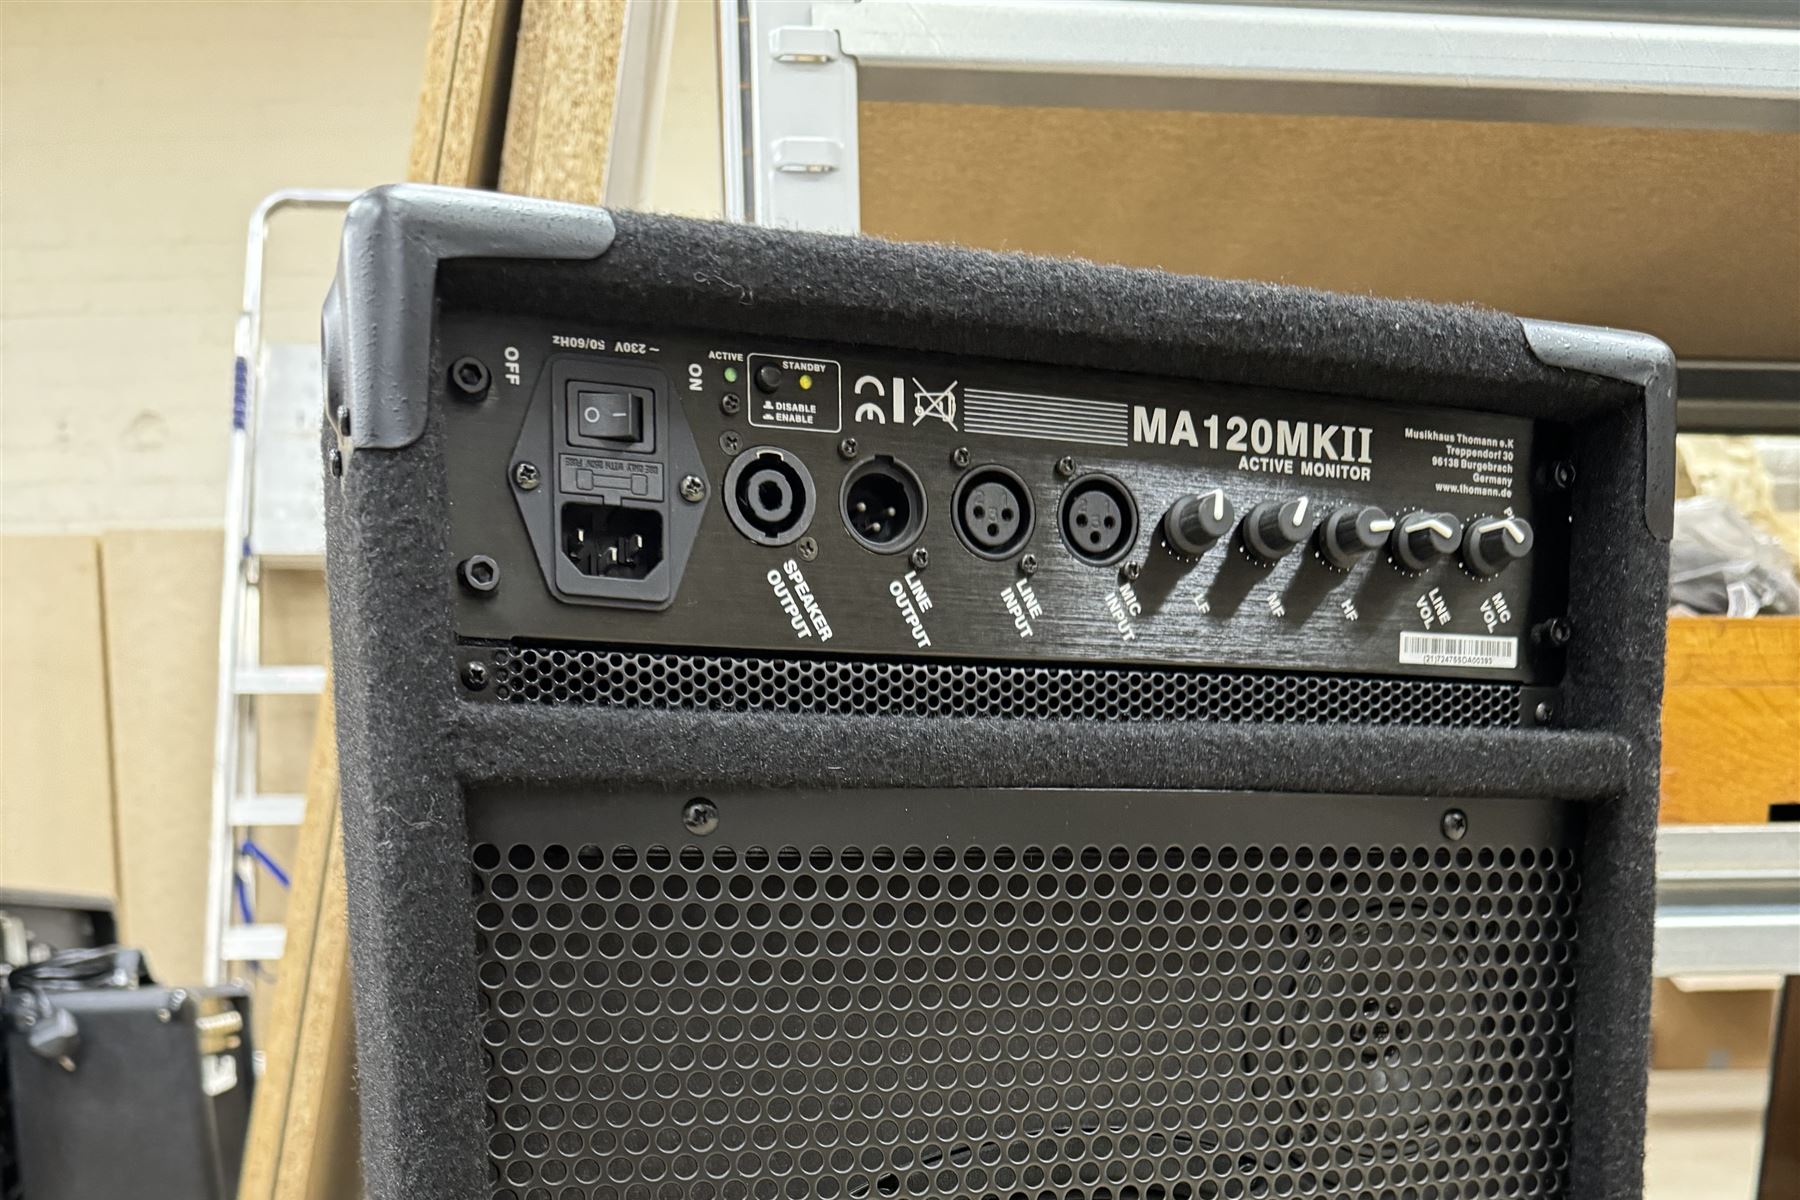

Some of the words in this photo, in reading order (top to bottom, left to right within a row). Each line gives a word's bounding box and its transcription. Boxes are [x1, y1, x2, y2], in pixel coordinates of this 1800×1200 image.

[552, 335, 606, 350] 50/60Hz
[614, 341, 647, 354] 230V
[708, 350, 744, 362] ACTIVE
[504, 346, 520, 386] OFF
[688, 363, 703, 391] ON
[782, 360, 826, 373] STANDBY
[775, 401, 817, 414] DISABLE
[775, 412, 814, 424] ENABLE
[1133, 405, 1373, 463] MA120MKII
[1404, 427, 1455, 442] Musikhaus
[1456, 433, 1498, 448] Thomann
[1431, 456, 1459, 469] 96138
[1460, 458, 1513, 474] Burgebrach
[1446, 444, 1501, 459] Treppendorf
[1502, 451, 1514, 461] 30
[1238, 455, 1294, 475] ACTIVE
[1300, 460, 1372, 482] MONITOR
[1472, 472, 1513, 488] Germany
[1435, 482, 1512, 498] www.thomann.de
[766, 569, 812, 641] OUTPUT
[783, 559, 833, 642] SPEAKER
[904, 570, 933, 613] LINE
[1016, 577, 1043, 620] LINE
[1119, 583, 1142, 617] MIC
[1194, 593, 1211, 614] LF
[1267, 592, 1285, 617] MF
[889, 580, 931, 648] OUTPUT
[1000, 586, 1033, 638] INPUT
[1104, 591, 1136, 641] INPUT
[1341, 598, 1359, 621] HF
[1416, 594, 1435, 631] VOL
[1428, 587, 1452, 626] LINE
[1480, 598, 1498, 634] VOL
[1491, 591, 1512, 623] MIC
